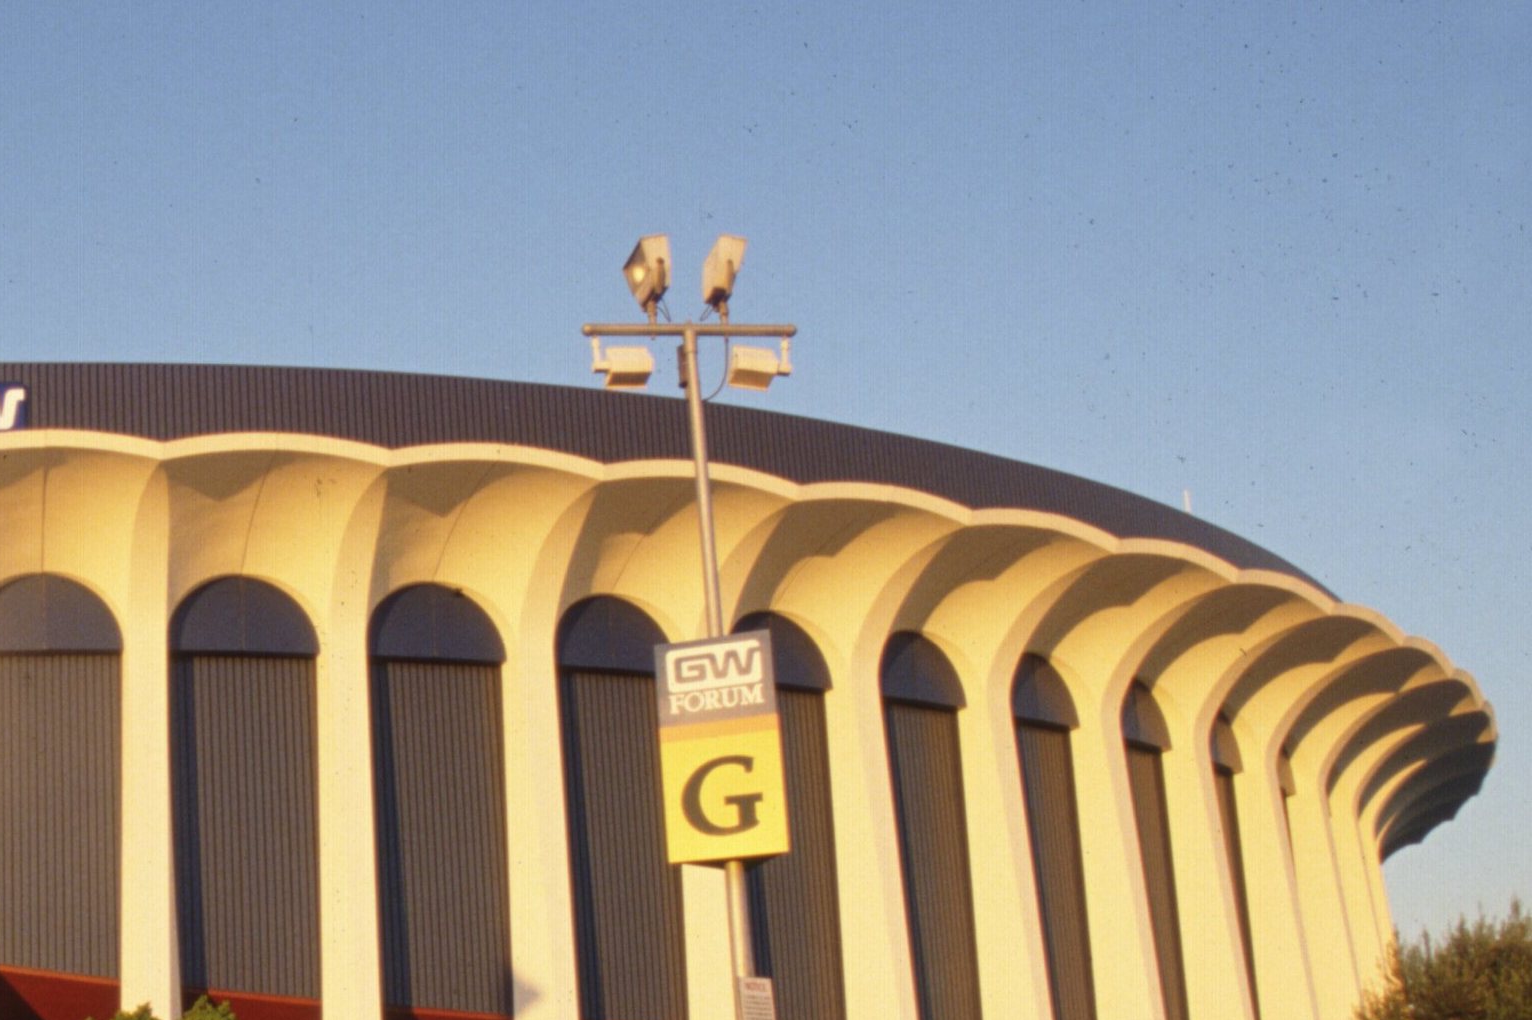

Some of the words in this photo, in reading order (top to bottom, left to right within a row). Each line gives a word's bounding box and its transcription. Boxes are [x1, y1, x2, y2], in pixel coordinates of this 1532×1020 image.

[673, 646, 762, 685] GW
[669, 683, 765, 714] FORUM
[681, 755, 763, 836] G
